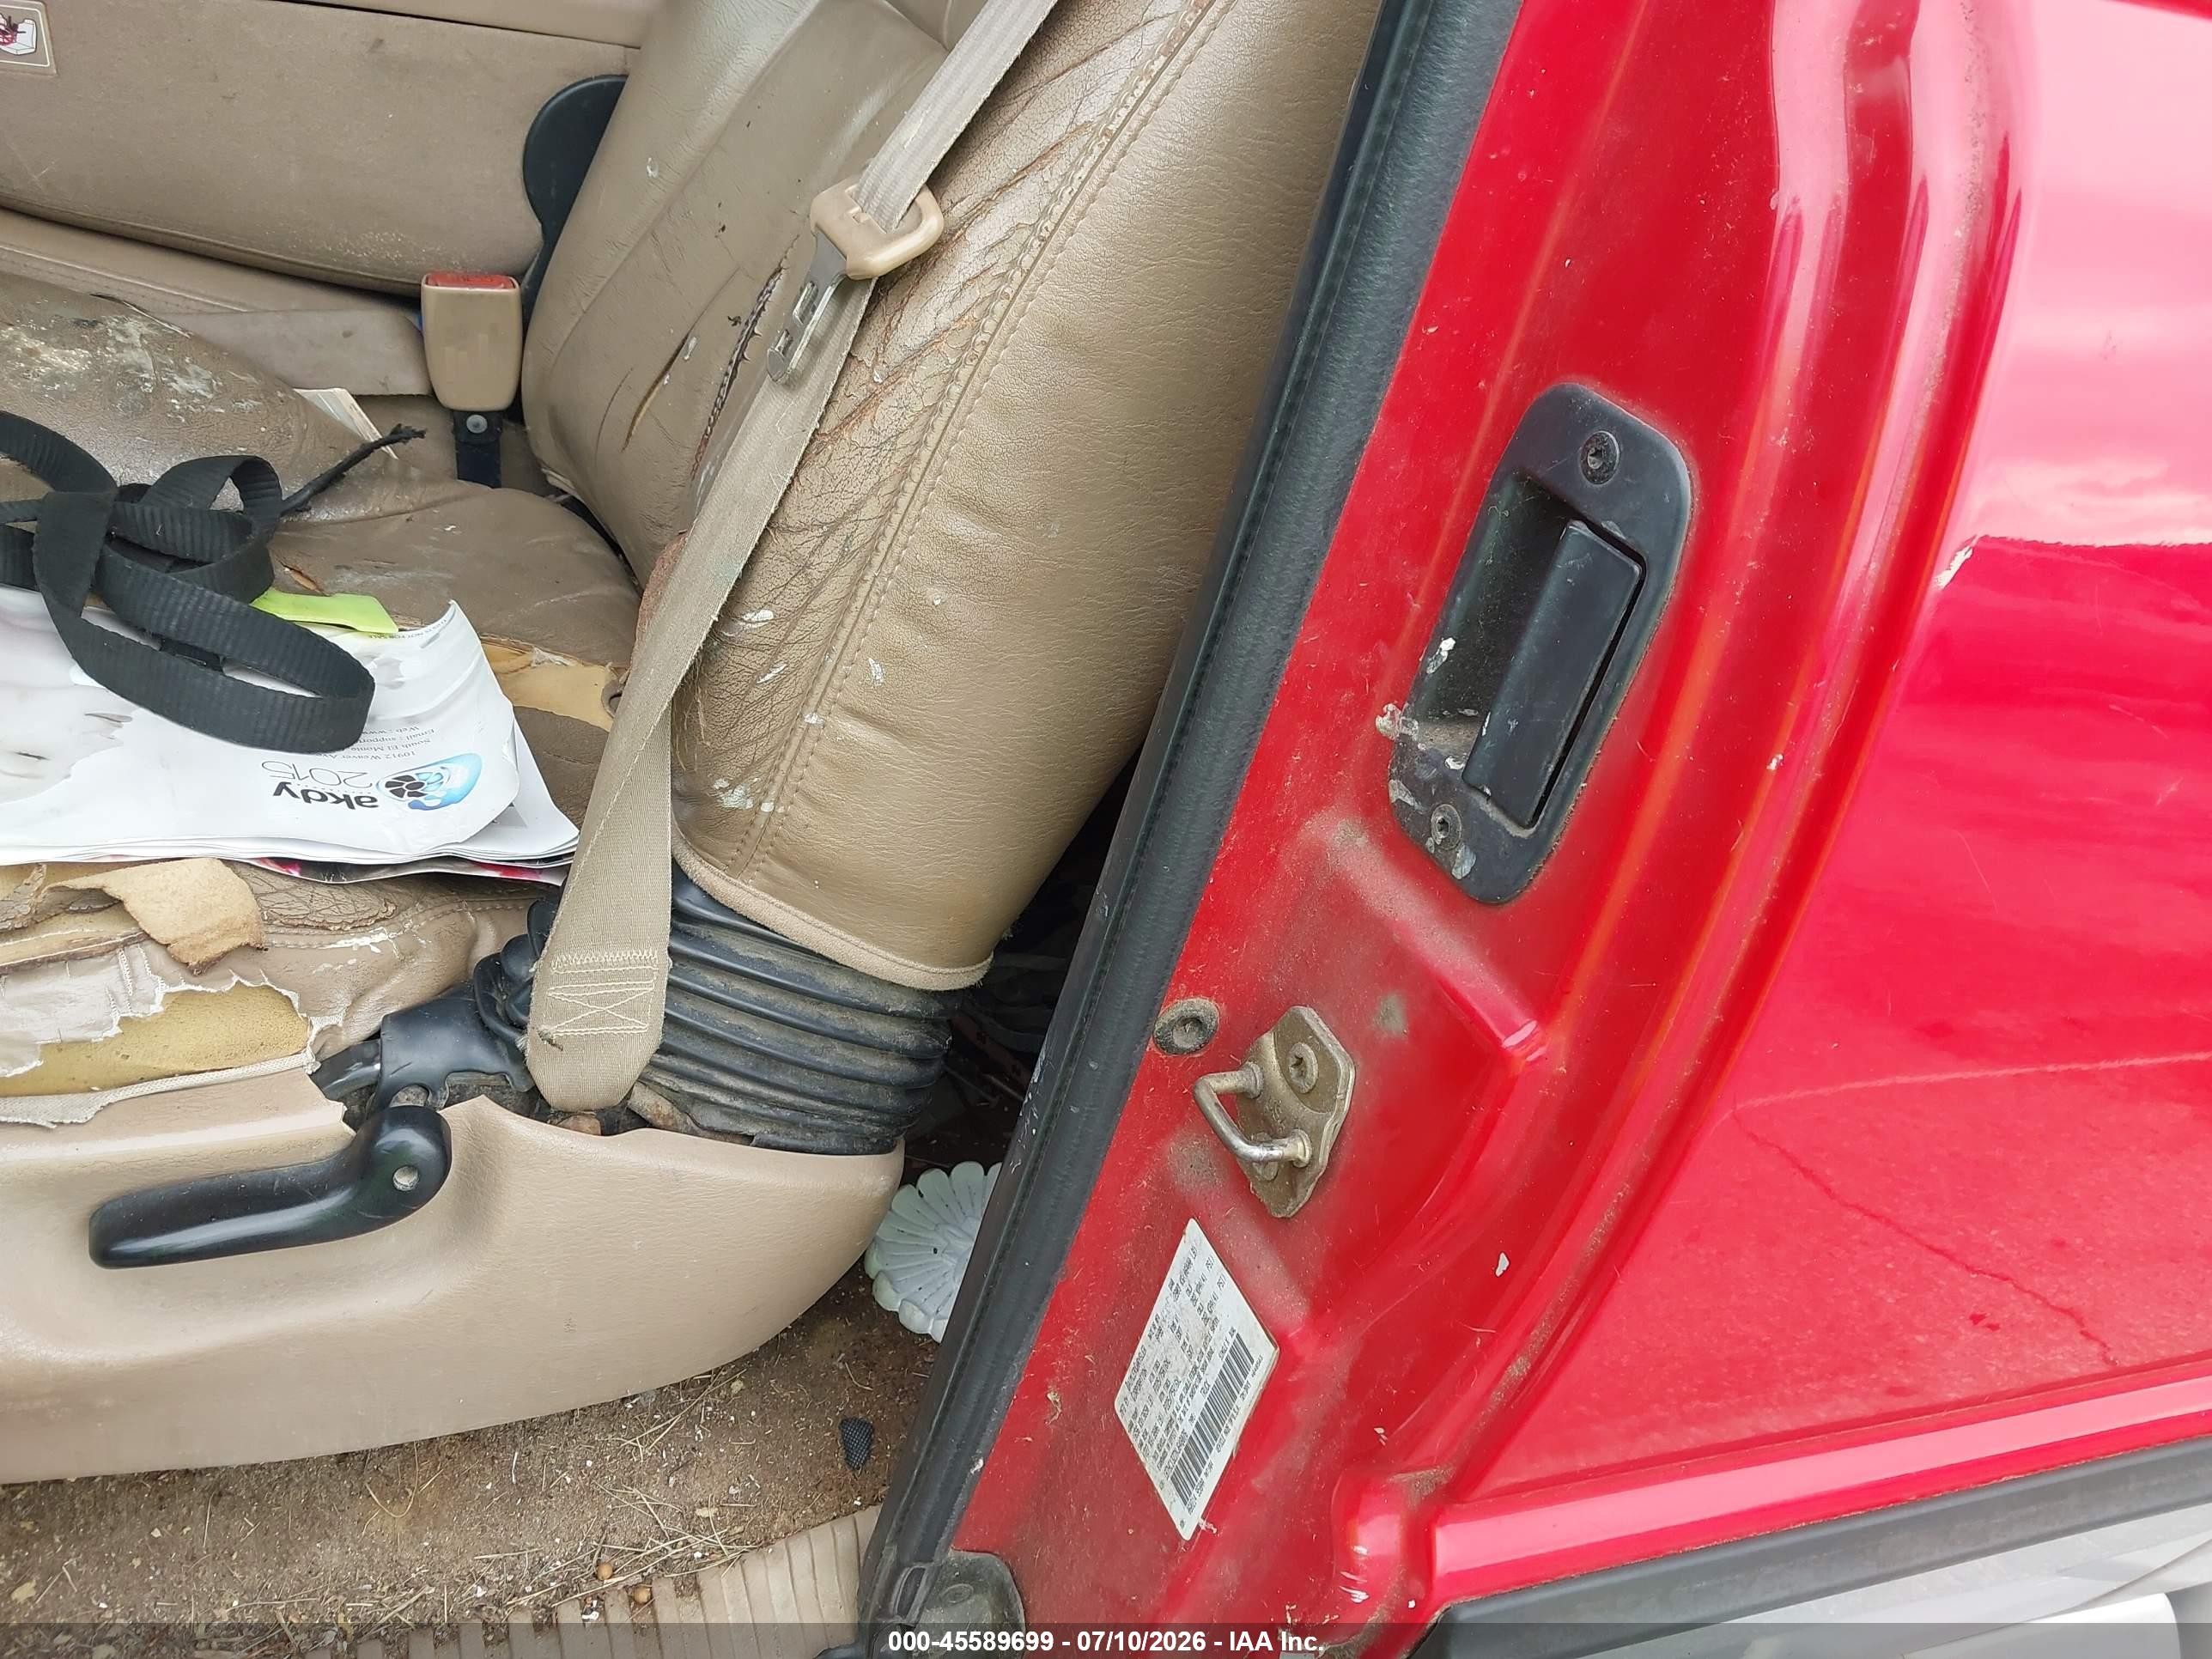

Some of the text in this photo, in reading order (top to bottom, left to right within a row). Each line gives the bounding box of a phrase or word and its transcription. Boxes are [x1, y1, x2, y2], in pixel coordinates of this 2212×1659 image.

[400, 738, 431, 750] South
[406, 728, 434, 741] Email
[261, 761, 373, 788] 2015
[272, 781, 380, 810] akdy
